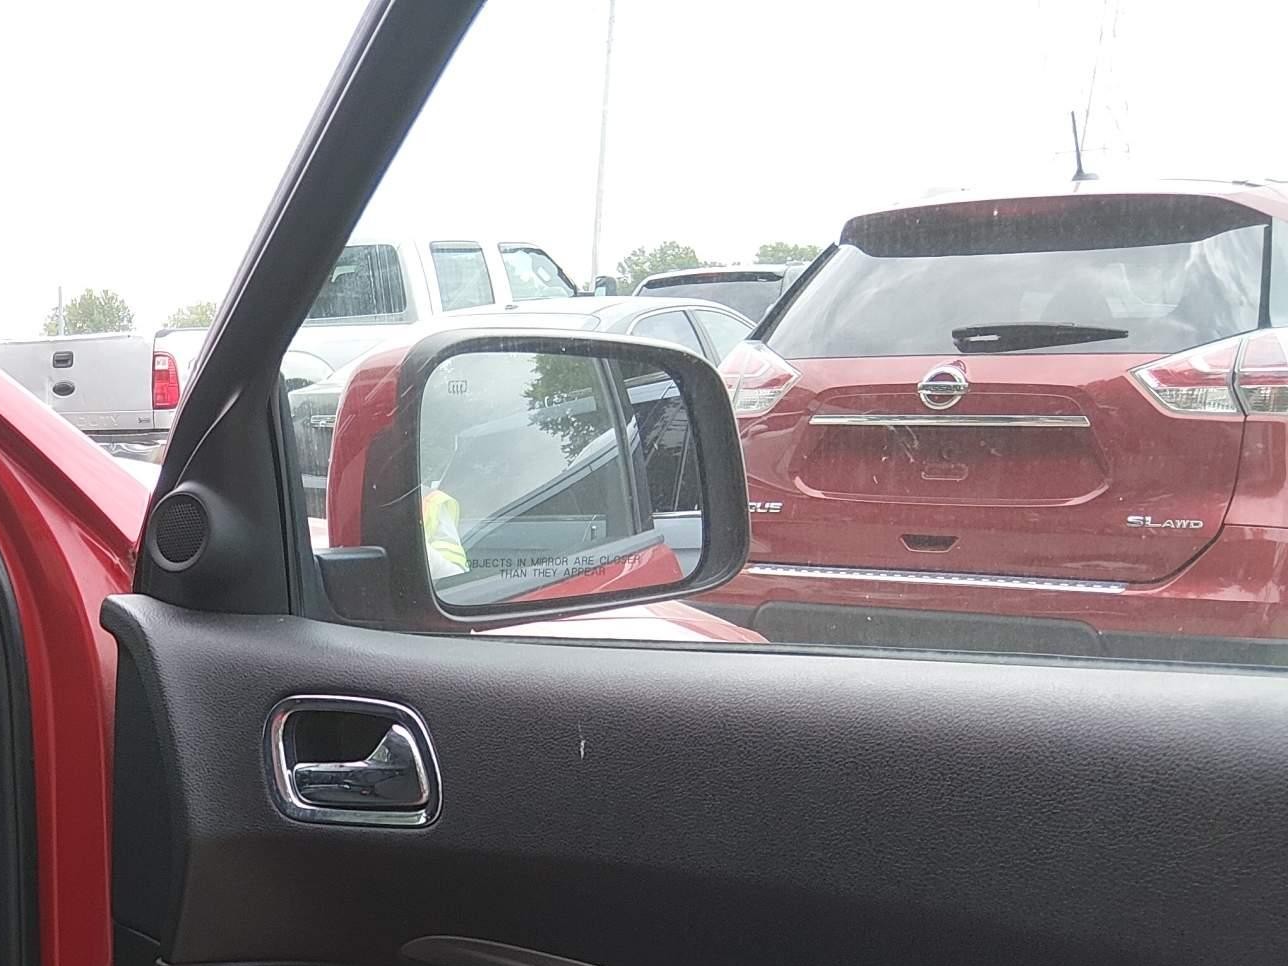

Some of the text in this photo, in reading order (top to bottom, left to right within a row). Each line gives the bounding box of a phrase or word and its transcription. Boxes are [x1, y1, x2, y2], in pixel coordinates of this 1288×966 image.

[465, 554, 641, 569] OBJECTS IN MIRROR ARE CLOSER
[500, 566, 606, 579] THAN THEY APPEAR
